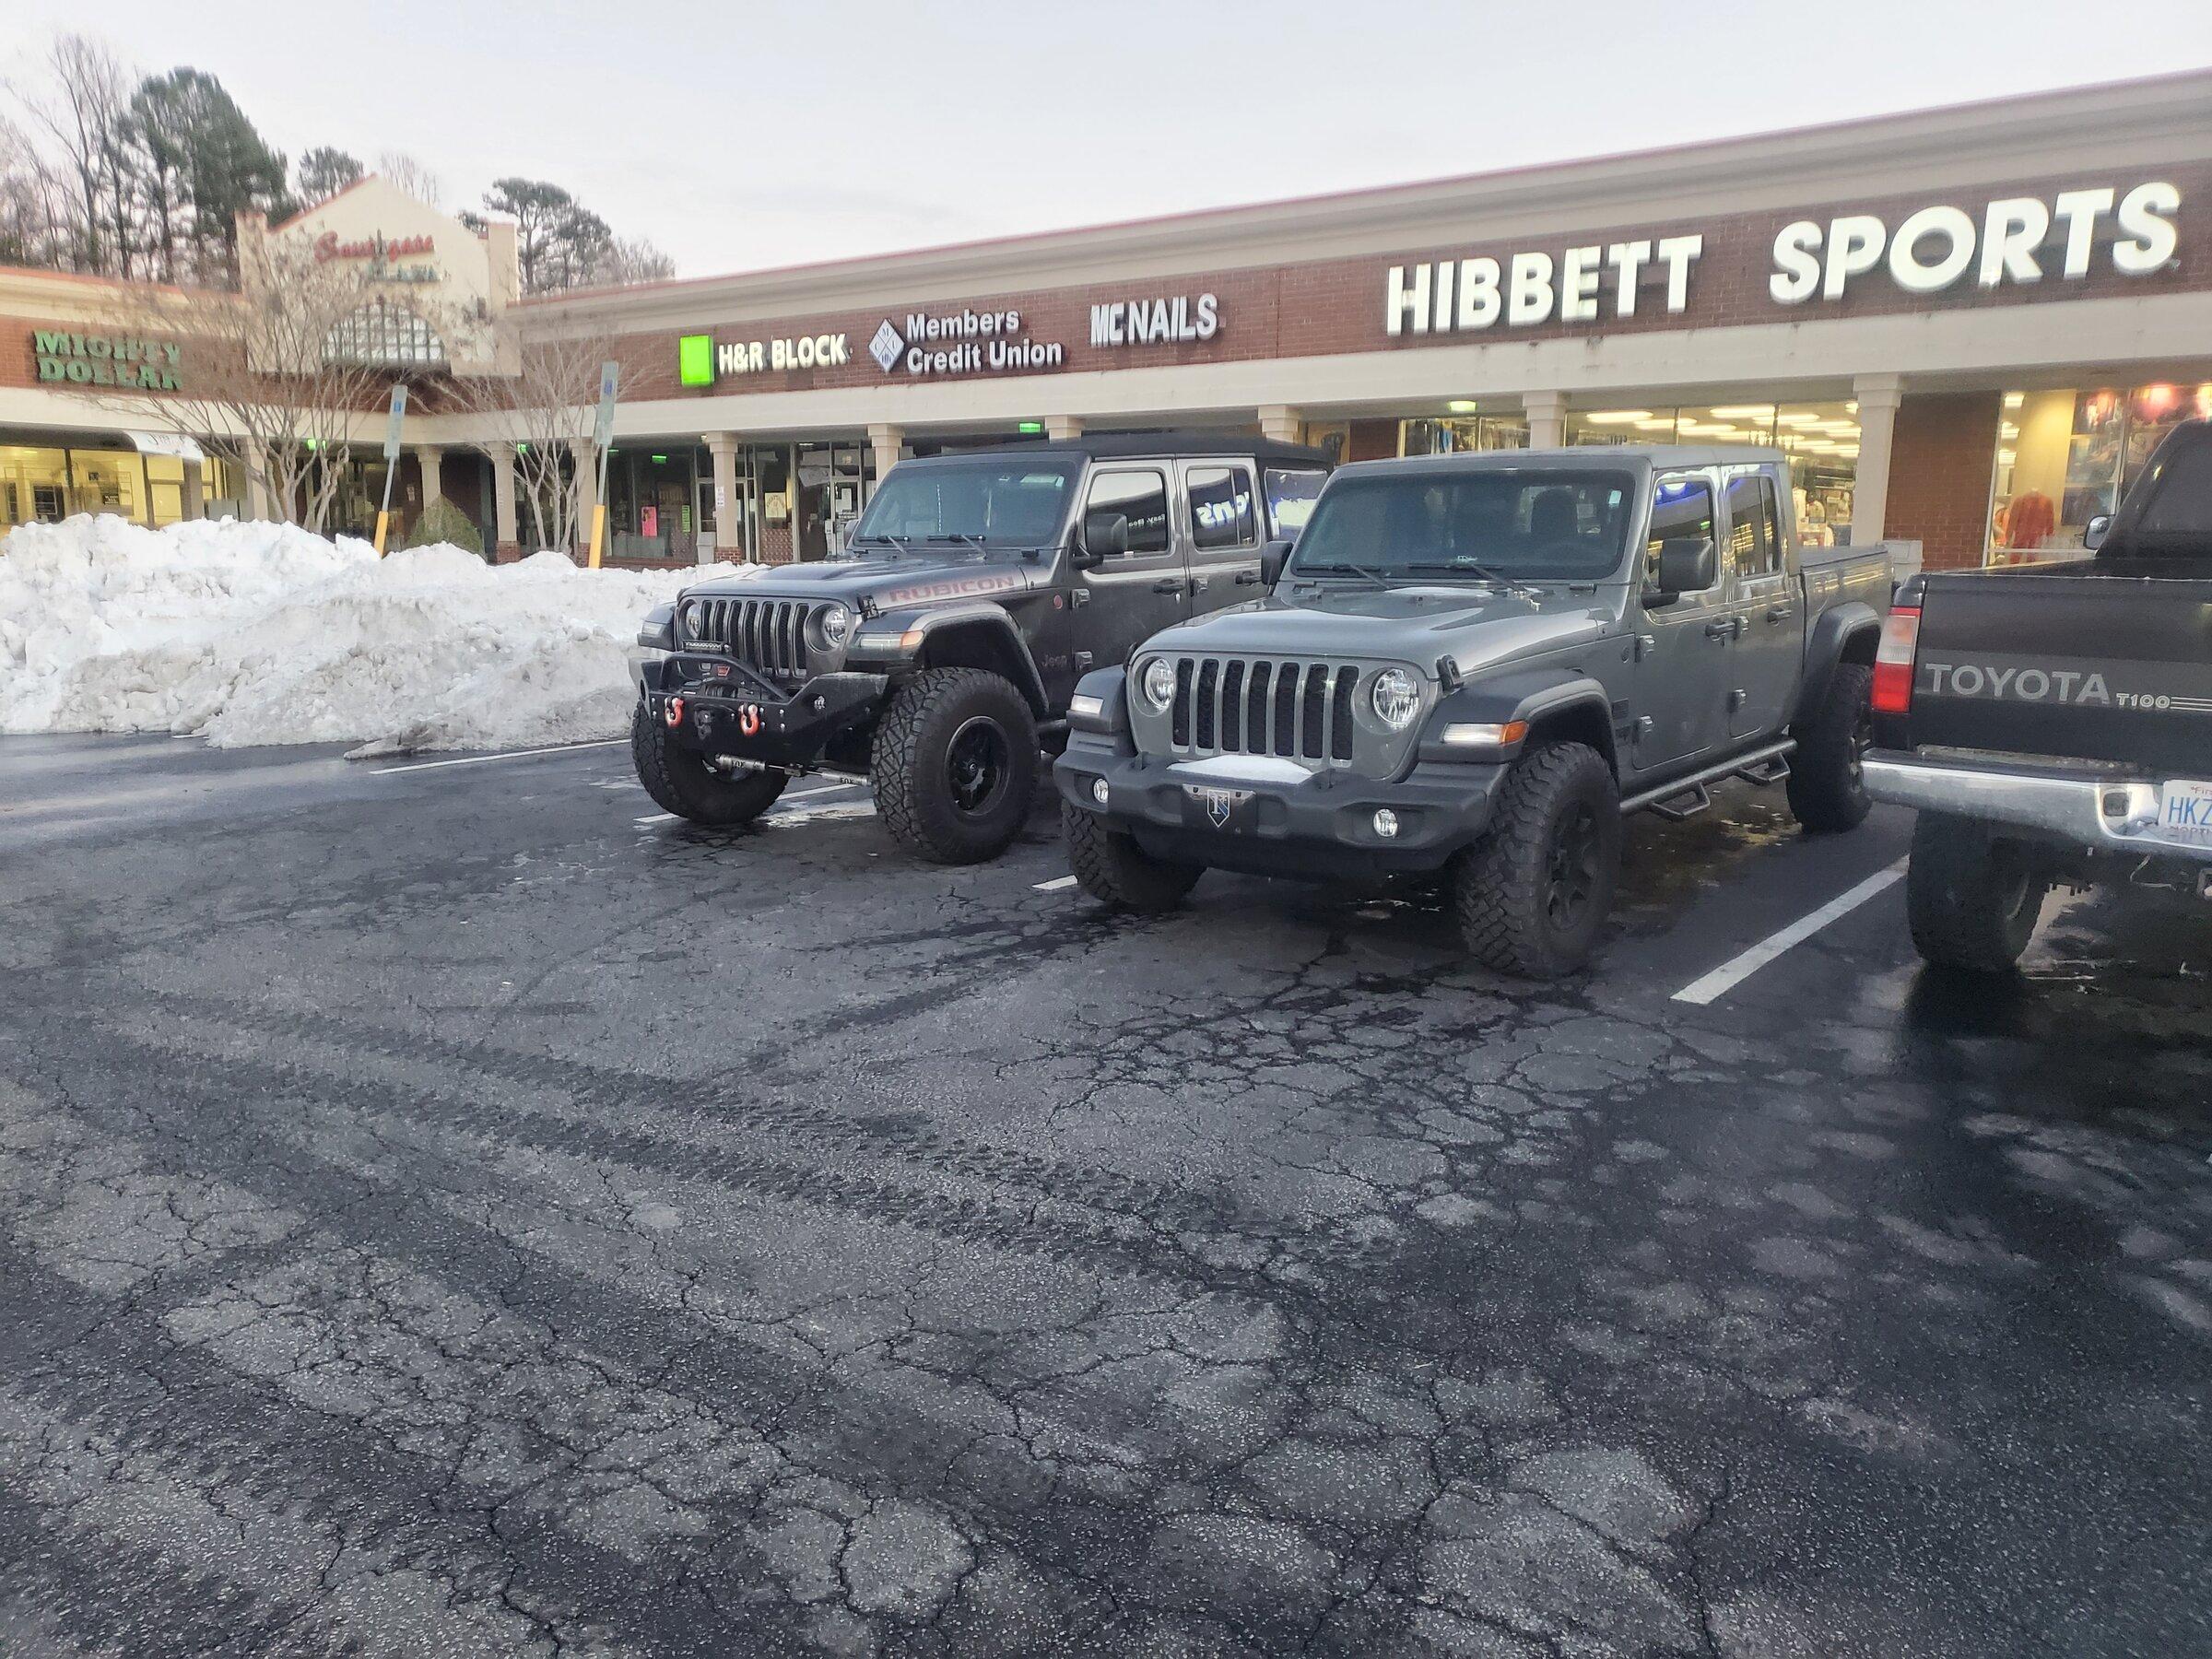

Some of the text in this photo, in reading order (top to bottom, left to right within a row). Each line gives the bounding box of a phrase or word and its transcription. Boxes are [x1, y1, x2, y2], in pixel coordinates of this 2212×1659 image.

[1386, 182, 2182, 336] HIBBETT SPORTS
[906, 308, 1020, 342] Members
[1128, 293, 1218, 346] NAILS
[718, 333, 849, 376] H&R BLOCK
[906, 337, 1063, 376] Credit Union
[888, 576, 1014, 603] RUBICON
[1924, 663, 2171, 709] TOYOTA T100
